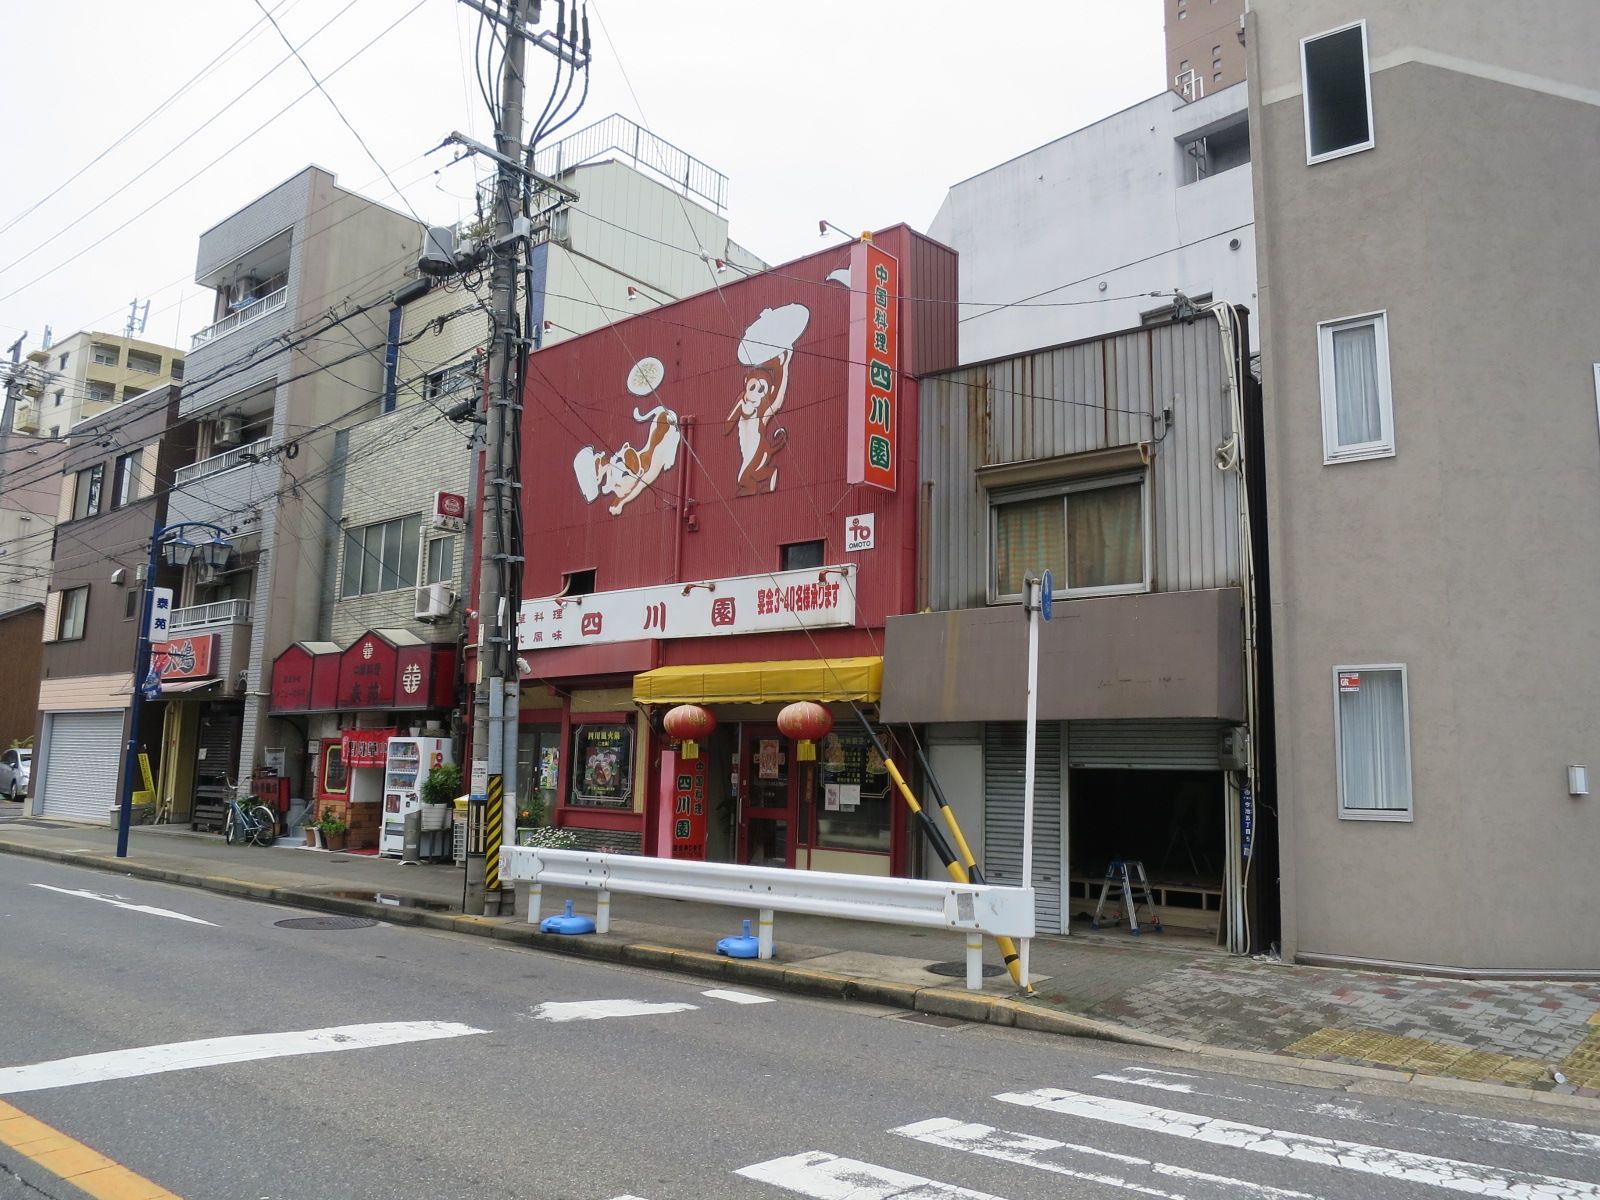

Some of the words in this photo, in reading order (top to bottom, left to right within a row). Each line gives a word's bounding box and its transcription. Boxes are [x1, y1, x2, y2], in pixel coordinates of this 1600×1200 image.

[874, 264, 889, 353] 中国料理
[868, 359, 892, 471] 四川園
[848, 541, 871, 549] OMOTO
[154, 597, 169, 630] 泰苑
[581, 597, 736, 637] 四川園
[675, 774, 693, 839] 四川園
